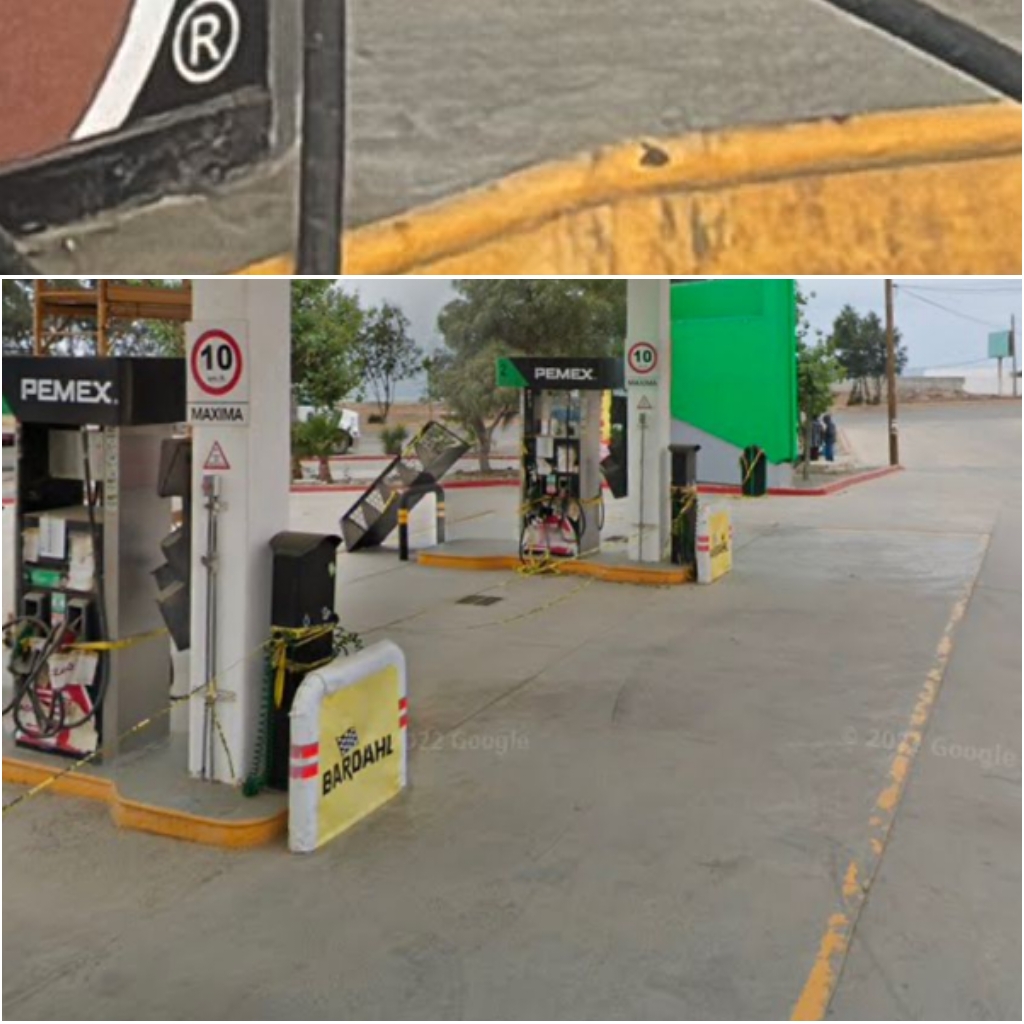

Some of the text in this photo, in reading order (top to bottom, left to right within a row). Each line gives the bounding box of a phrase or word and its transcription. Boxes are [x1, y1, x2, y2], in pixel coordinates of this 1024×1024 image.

[200, 343, 233, 372] 10
[633, 349, 653, 364] 10
[534, 367, 594, 381] PEMEX
[20, 378, 114, 404] PEMEX
[191, 406, 244, 422] MAXIMA
[322, 734, 394, 796] BARDAHL
